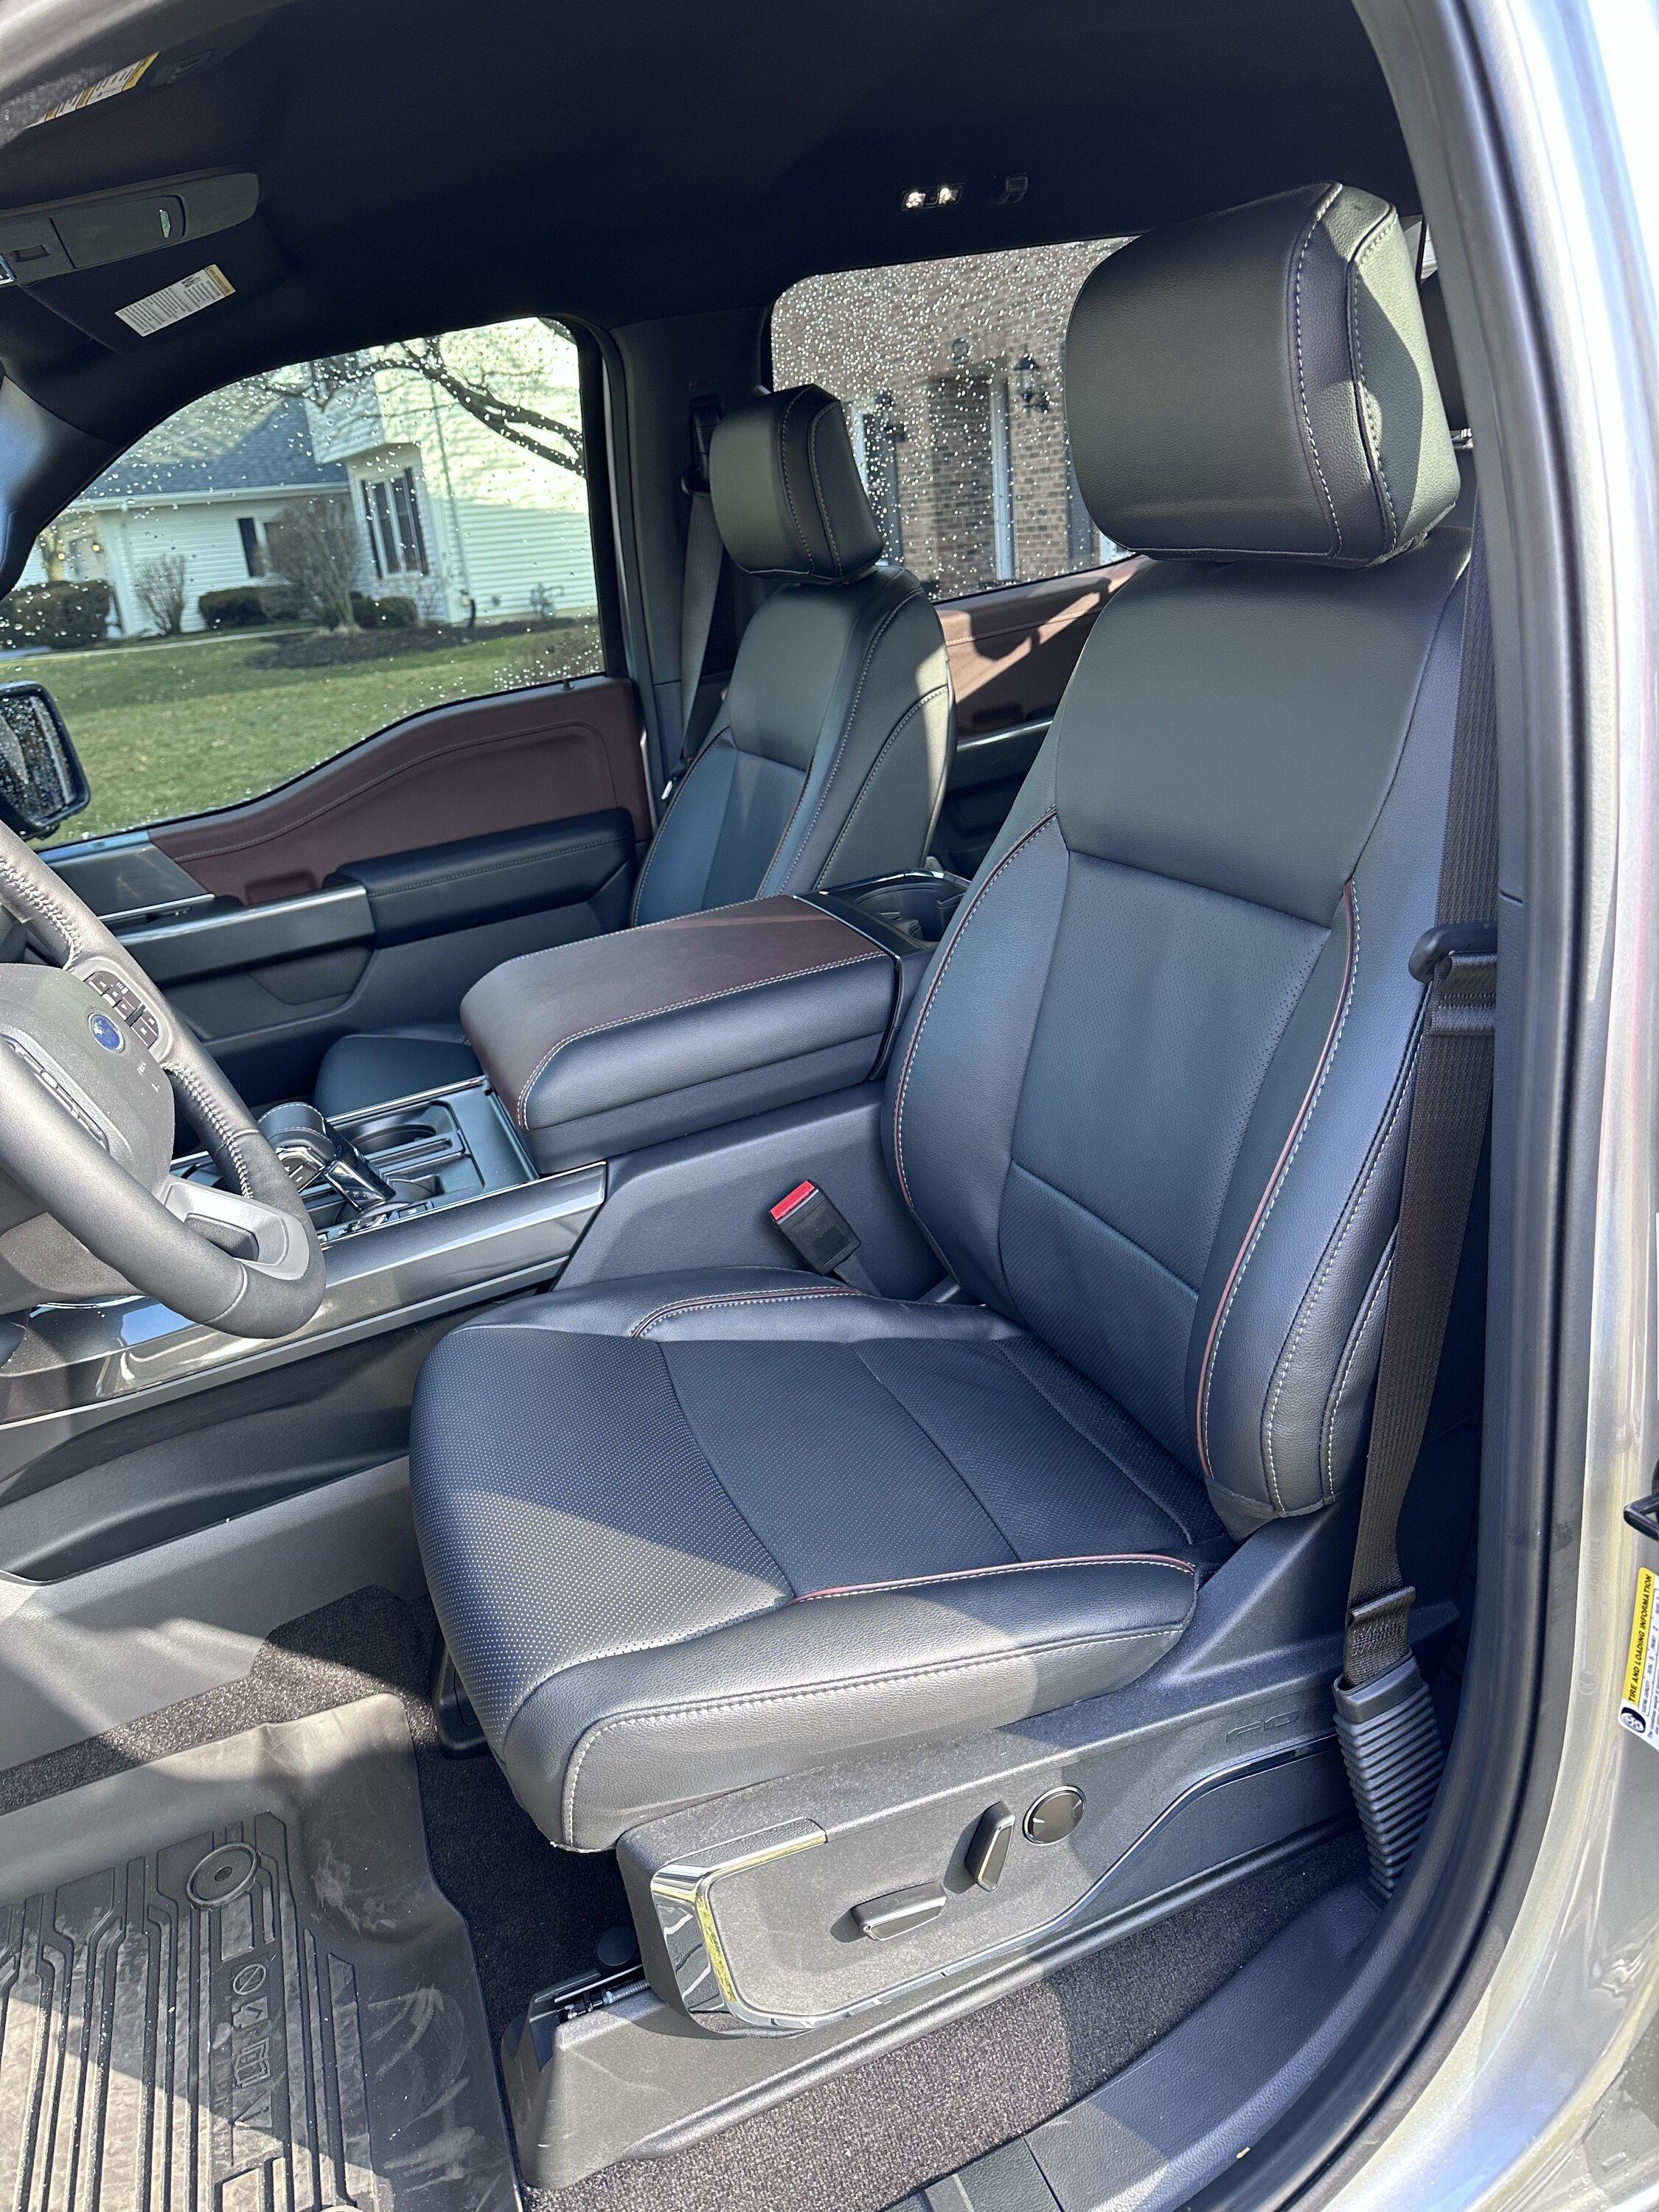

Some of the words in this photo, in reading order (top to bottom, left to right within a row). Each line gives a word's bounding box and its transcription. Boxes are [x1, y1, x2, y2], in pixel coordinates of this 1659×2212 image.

[1639, 1573, 1652, 1630] INFORMATION
[1634, 1630, 1645, 1666] LOADING
[1632, 1666, 1640, 1684] AND
[1628, 1683, 1638, 1703] TIRE
